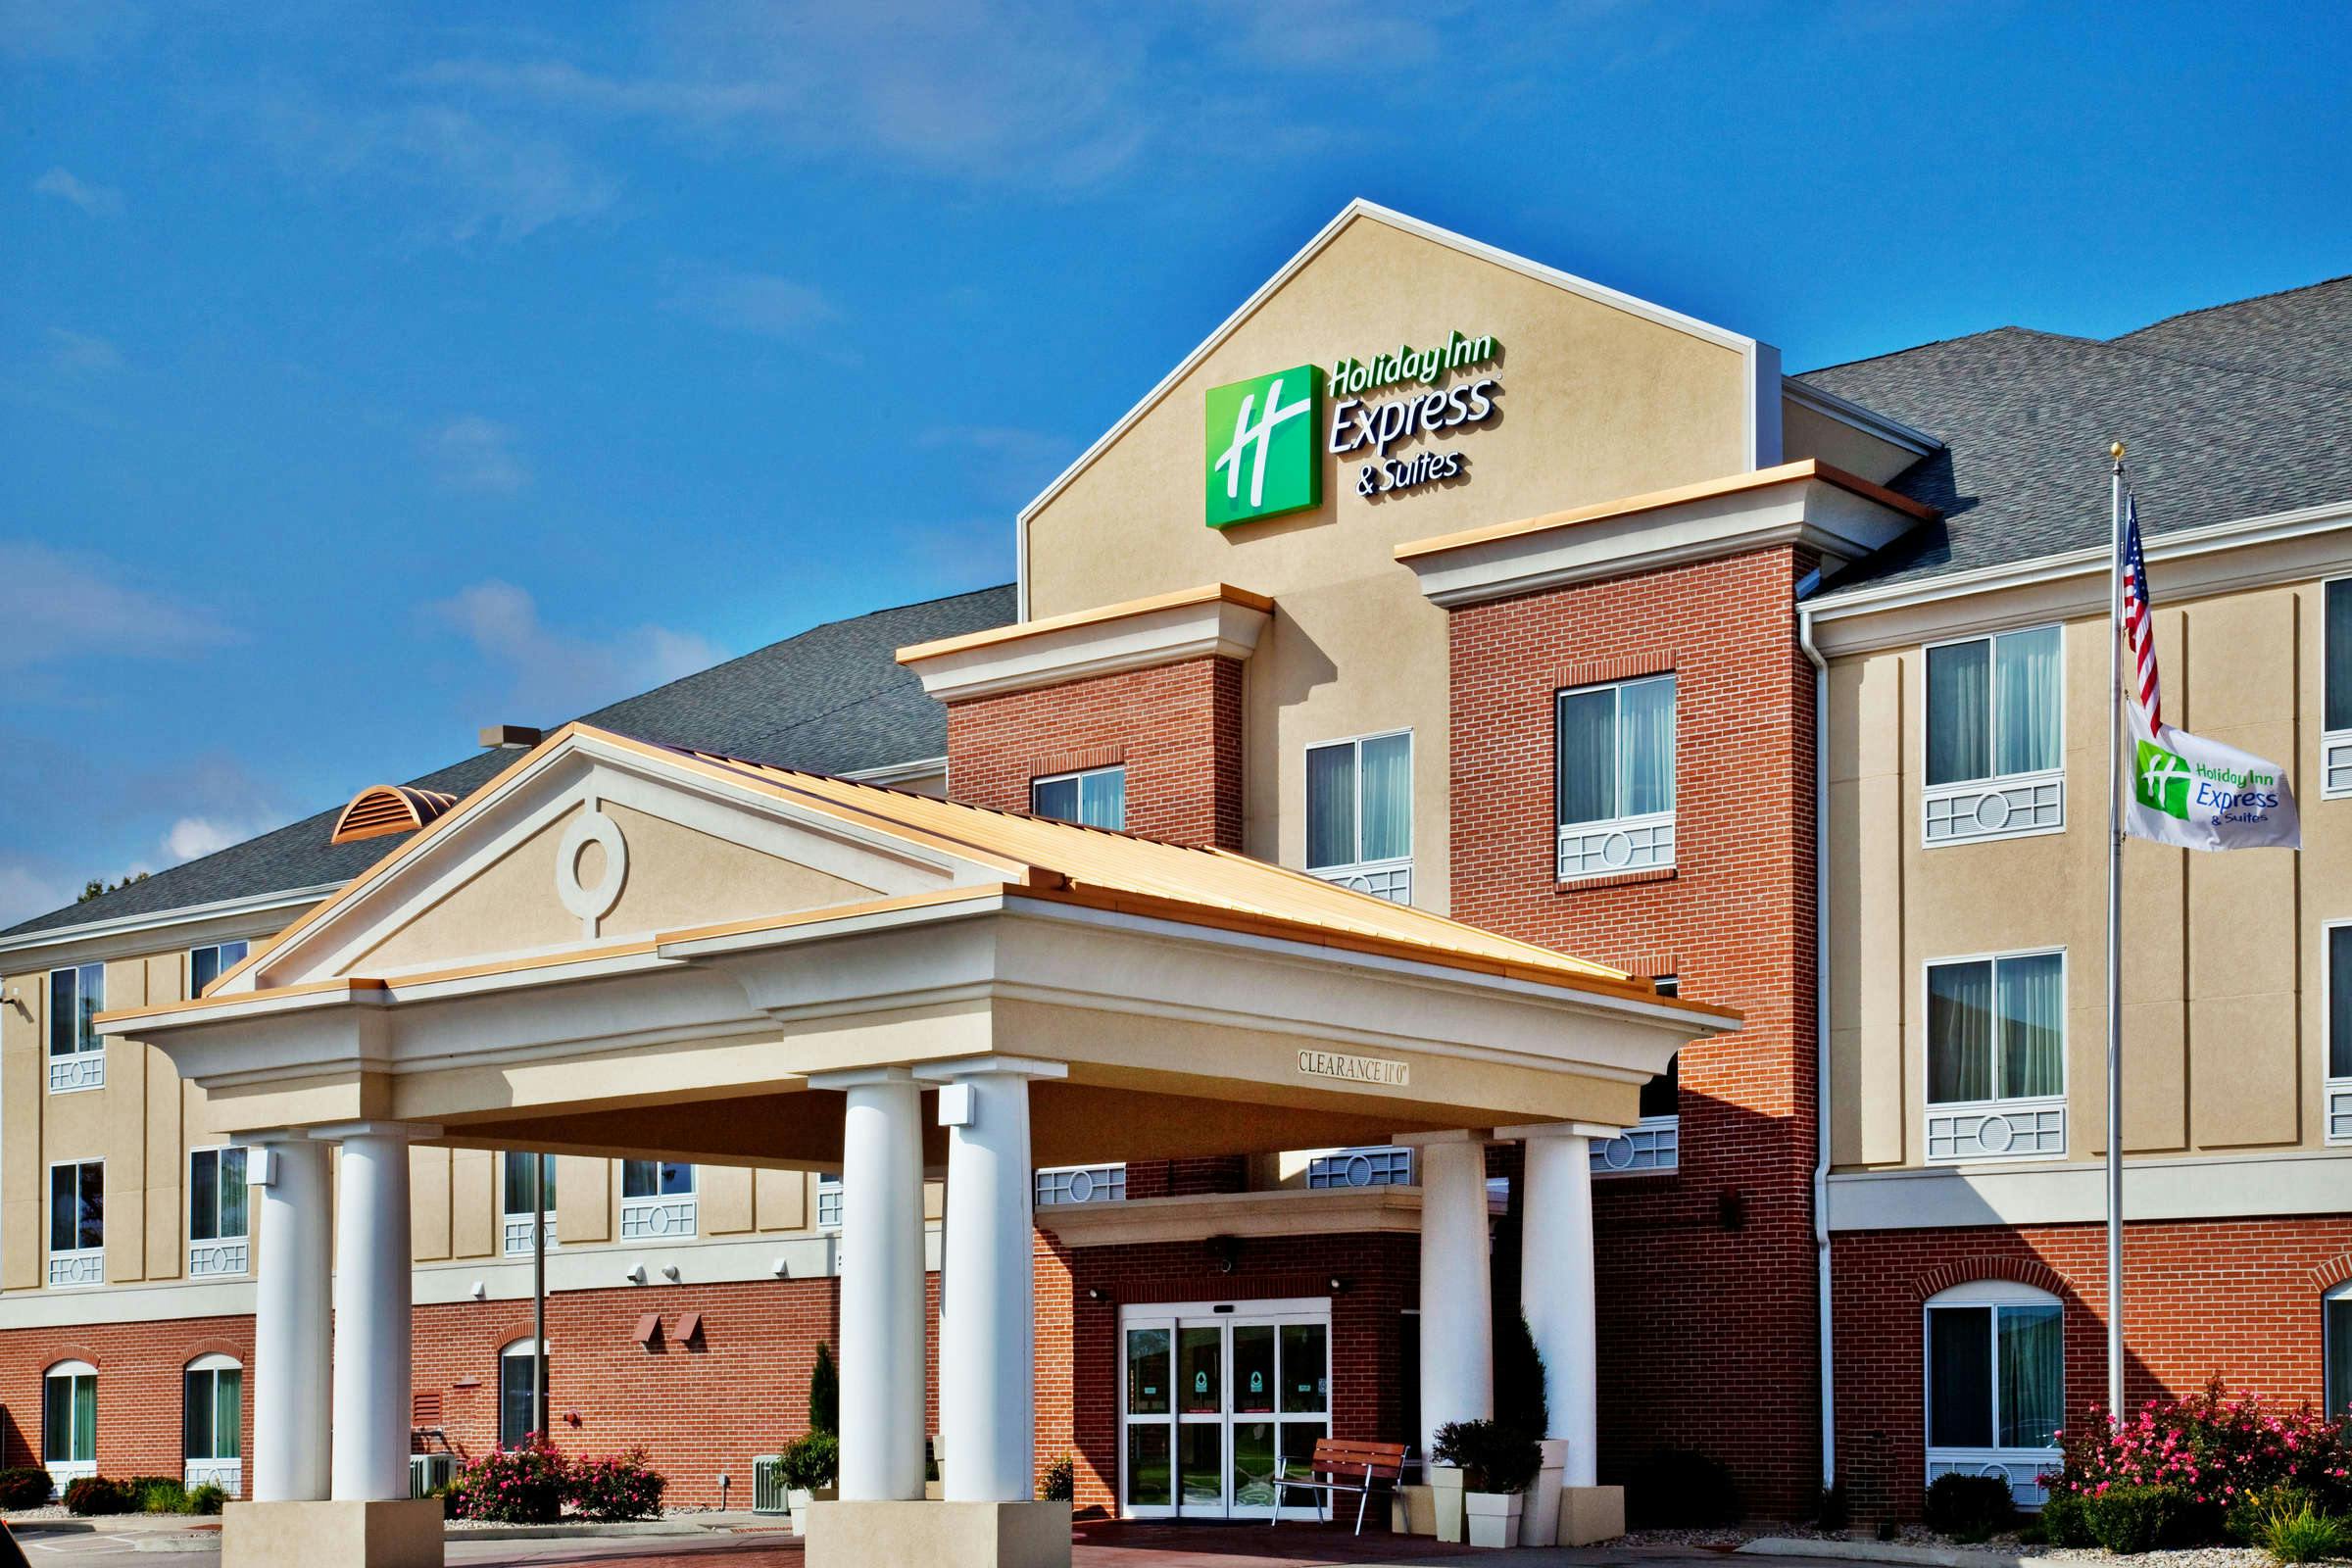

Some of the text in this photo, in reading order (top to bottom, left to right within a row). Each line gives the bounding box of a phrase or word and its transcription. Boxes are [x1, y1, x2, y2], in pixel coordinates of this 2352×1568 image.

[1328, 330, 1492, 398] Holiday Inn
[1328, 379, 1492, 457] Express
[1354, 452, 1459, 497] & Suites
[2195, 762, 2274, 789] Holiday Inn
[2195, 782, 2279, 814] Express
[2211, 813, 2269, 826] & Suites
[1298, 1051, 1382, 1081] CLEARANCE
